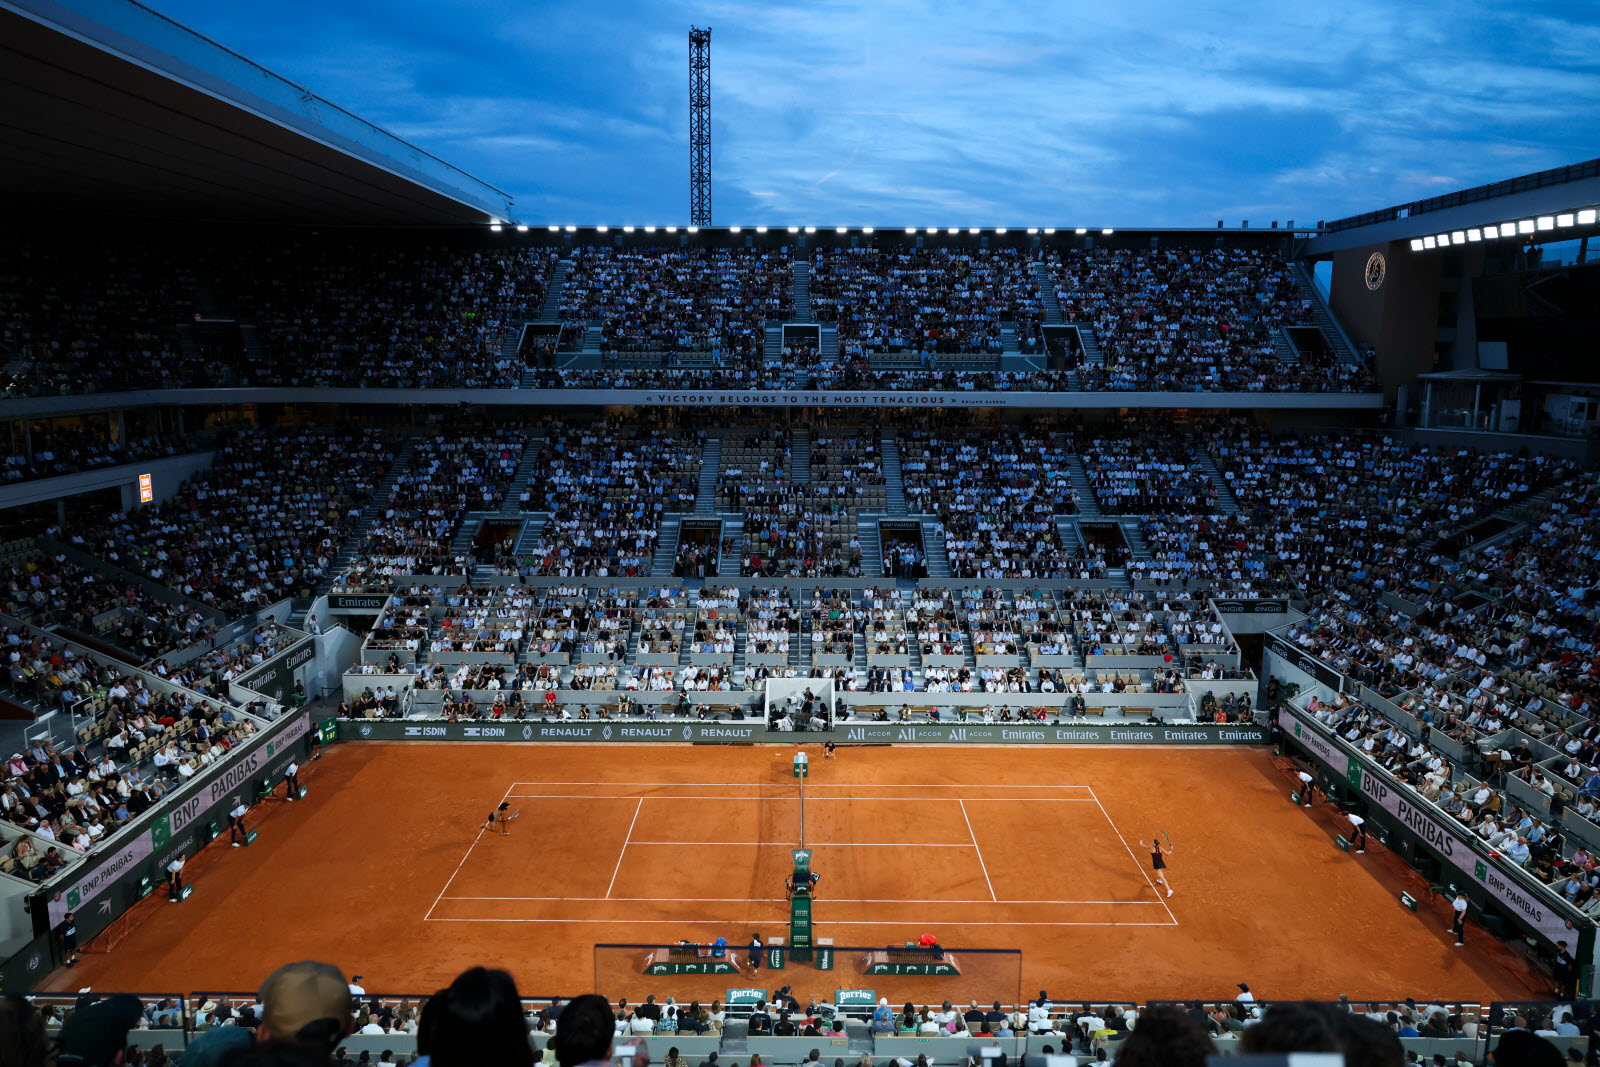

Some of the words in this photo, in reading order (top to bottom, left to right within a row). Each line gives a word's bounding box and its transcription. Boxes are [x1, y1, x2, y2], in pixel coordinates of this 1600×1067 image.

[658, 395, 713, 403] VICTORY
[873, 396, 945, 404] TENACIOUS
[338, 597, 381, 607] Emirates
[286, 646, 312, 670] Emirates
[247, 668, 277, 691] Emirates
[422, 727, 447, 736] ISDIN
[481, 727, 506, 737] ISDIN
[541, 728, 592, 736] RENAULT
[621, 728, 673, 736] RENAULT
[701, 728, 752, 737] RENAULT
[1002, 729, 1045, 740] Emirates
[1056, 729, 1100, 740] Emirates
[1110, 730, 1154, 740] Emirates
[1164, 730, 1208, 740] Emirates
[1219, 730, 1262, 741] Emirates
[172, 797, 200, 832] BNP
[211, 753, 258, 802] PARIBAS
[1363, 774, 1387, 802] BNP
[1397, 800, 1454, 857] PARIBAS
[82, 876, 99, 897] BNP
[101, 851, 133, 882] PARIBAS
[1488, 873, 1506, 892] BNP
[1506, 886, 1542, 923] PARIBAS
